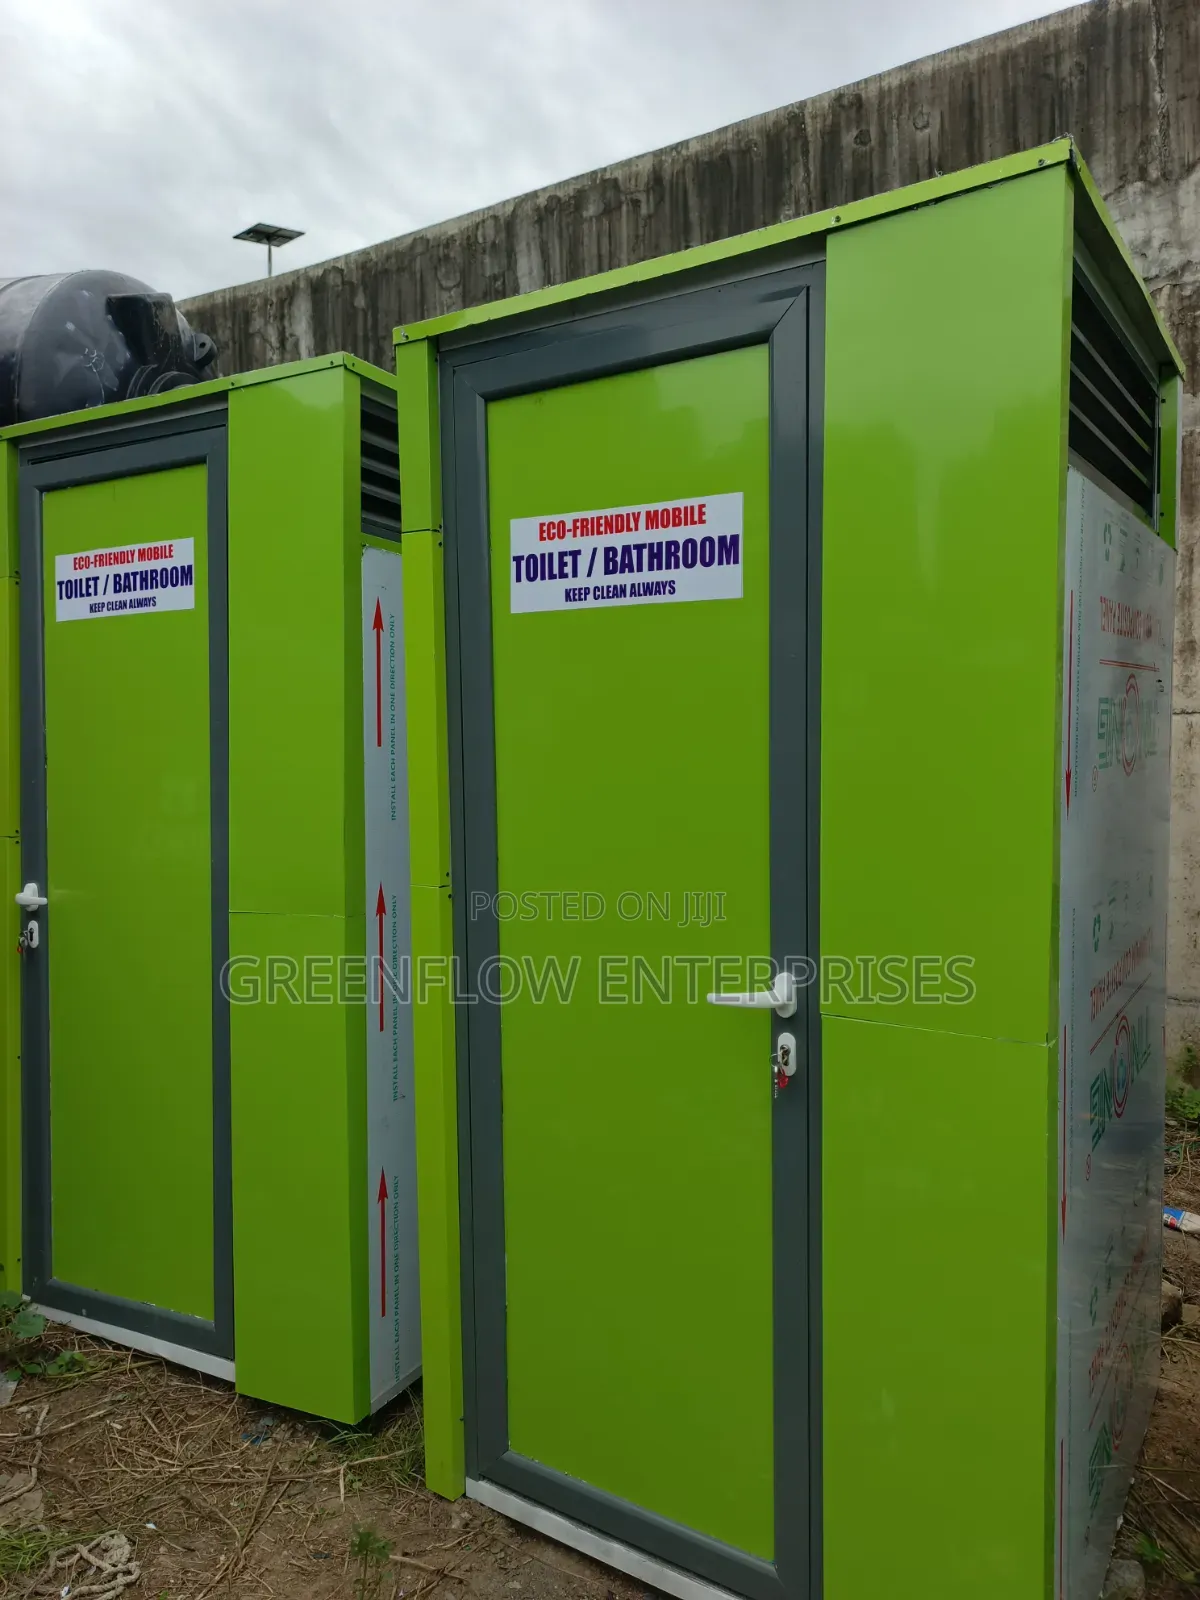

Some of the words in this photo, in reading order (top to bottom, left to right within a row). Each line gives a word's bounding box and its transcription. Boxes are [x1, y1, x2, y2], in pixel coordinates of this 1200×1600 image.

[539, 511, 642, 542] ECO-FRIENDLY
[645, 503, 707, 531] MOBILE
[73, 549, 136, 571] ECO-FRIENDLY
[138, 544, 174, 563] MOBILE
[512, 549, 582, 583] TOILET
[586, 547, 598, 578] /
[603, 533, 740, 576] BATHROOM
[57, 576, 100, 600] TOILET
[103, 574, 109, 595] /
[113, 564, 193, 594] BATHROOM
[564, 586, 591, 603] KEEP
[592, 583, 627, 600] CLEAN
[629, 579, 676, 598] ALWAYS
[89, 601, 106, 614] KEEP
[106, 599, 128, 612] CLEAN
[128, 596, 157, 610] ALWAYS
[390, 712, 396, 724] IN
